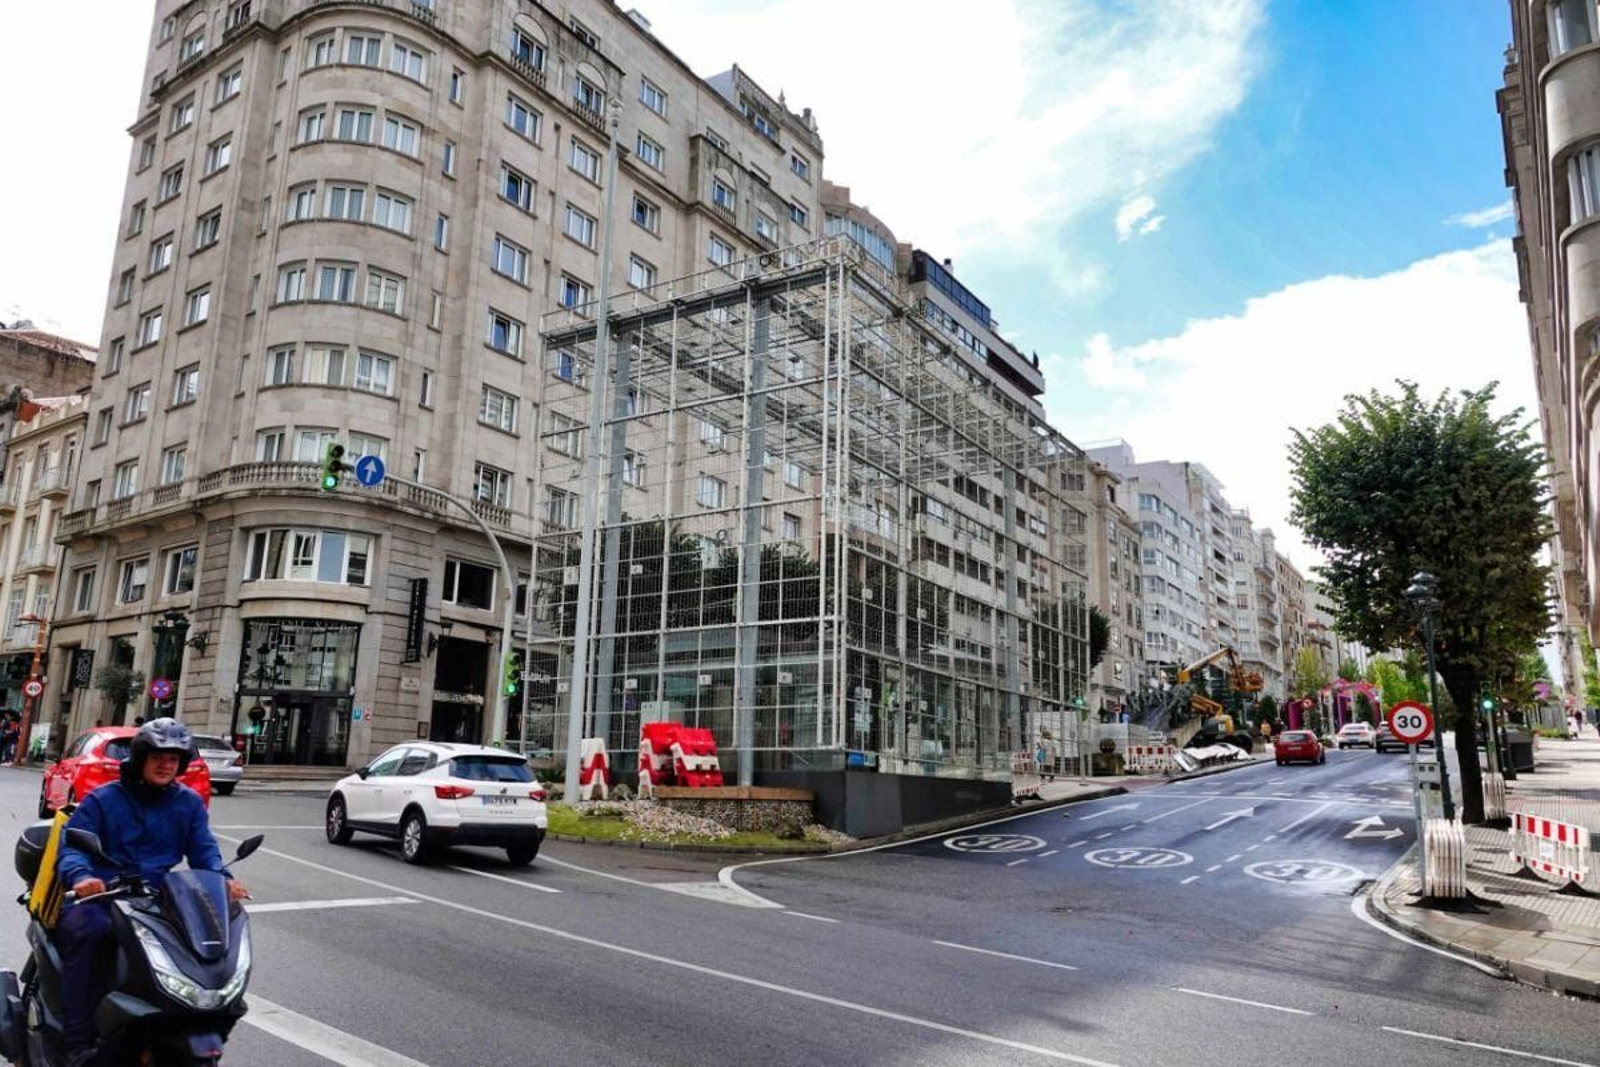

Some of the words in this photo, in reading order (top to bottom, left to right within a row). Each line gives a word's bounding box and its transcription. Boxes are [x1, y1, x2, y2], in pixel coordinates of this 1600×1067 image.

[27, 684, 41, 693] 40
[1397, 715, 1422, 729] 30
[957, 836, 1032, 849] 30
[1100, 850, 1176, 865] 30
[1262, 863, 1340, 879] 30
